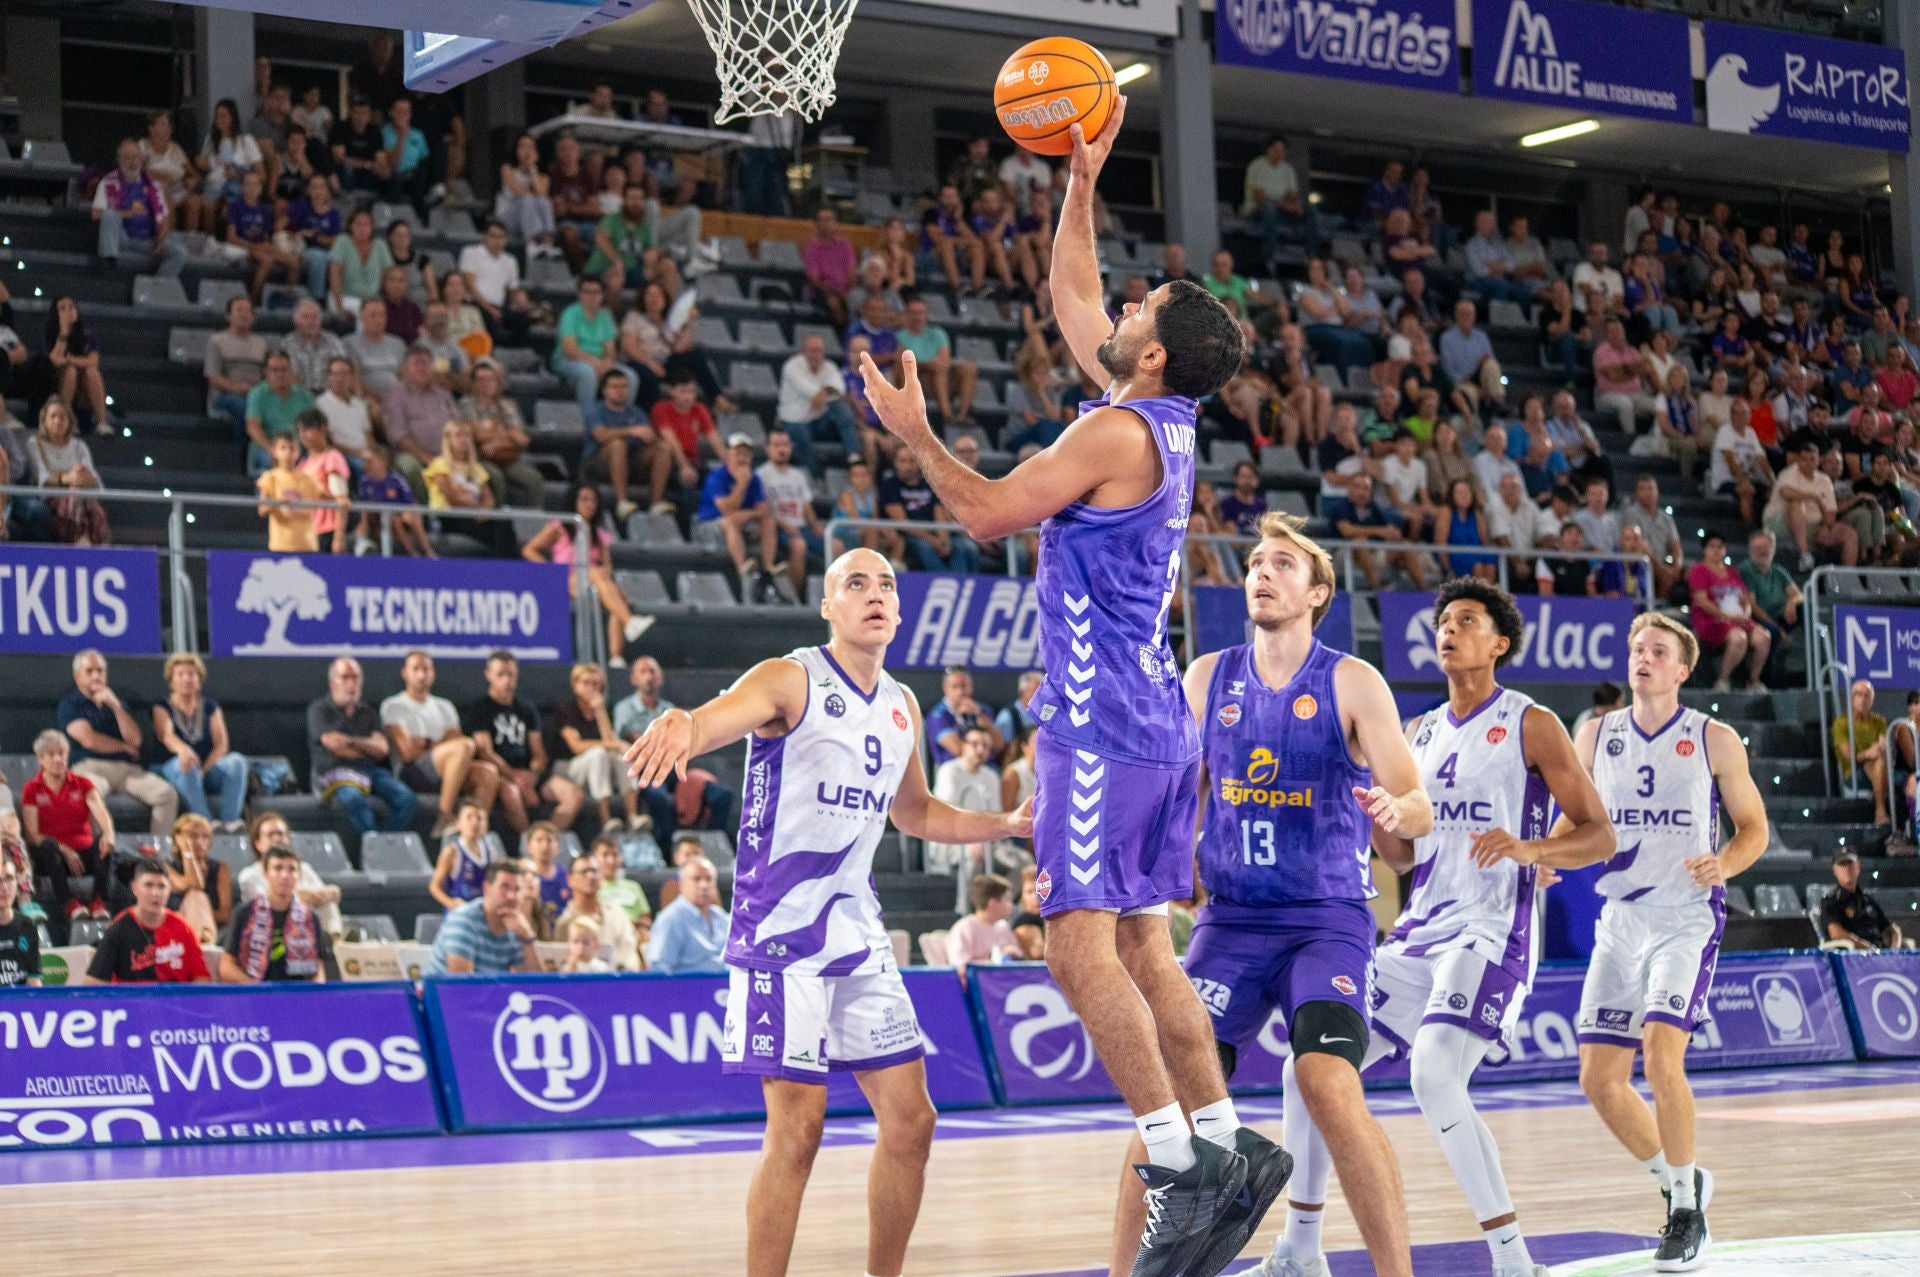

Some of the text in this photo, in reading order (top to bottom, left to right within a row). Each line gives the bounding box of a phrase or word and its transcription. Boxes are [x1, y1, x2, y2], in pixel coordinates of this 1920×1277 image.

[1295, 1, 1450, 76] Valdés
[1511, 54, 1581, 98] ALDE
[1785, 51, 1907, 108] RAPTOR
[1836, 108, 1851, 126] de
[1853, 110, 1910, 134] Transporte
[345, 586, 539, 637] TECNICAMPO
[905, 577, 1045, 668] ALCO
[864, 734, 882, 776] 9
[1436, 752, 1459, 788] 4
[1221, 785, 1313, 809] agropal
[1636, 765, 1656, 798] 3
[1240, 819, 1277, 866] 13
[150, 1024, 271, 1046] consultores
[752, 1034, 775, 1051] CBC
[152, 1035, 428, 1093] MODOS
[25, 1074, 151, 1097] ARQUITECTURA
[170, 1118, 367, 1141] INGENIERIA
